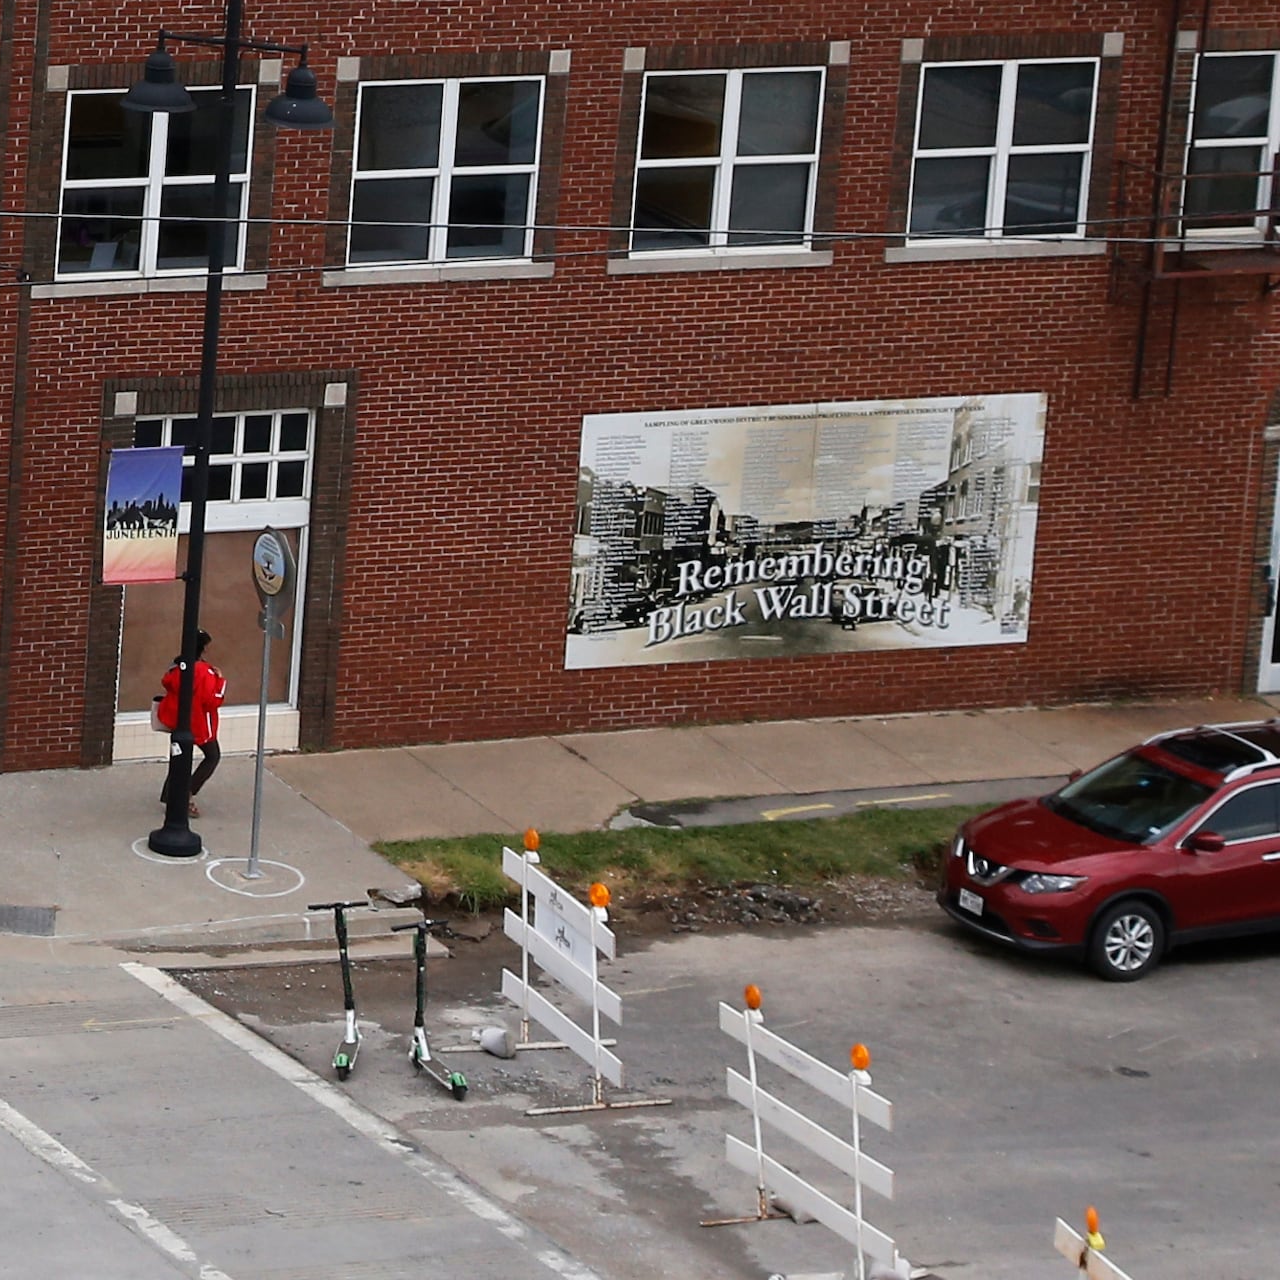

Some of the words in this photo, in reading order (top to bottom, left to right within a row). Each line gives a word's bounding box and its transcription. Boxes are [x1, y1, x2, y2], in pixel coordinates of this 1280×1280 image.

[106, 527, 177, 540] JUNETEENTH
[675, 541, 929, 597] Remembering
[645, 589, 747, 647] Black
[753, 581, 833, 620] Wall
[842, 583, 951, 629] Street
